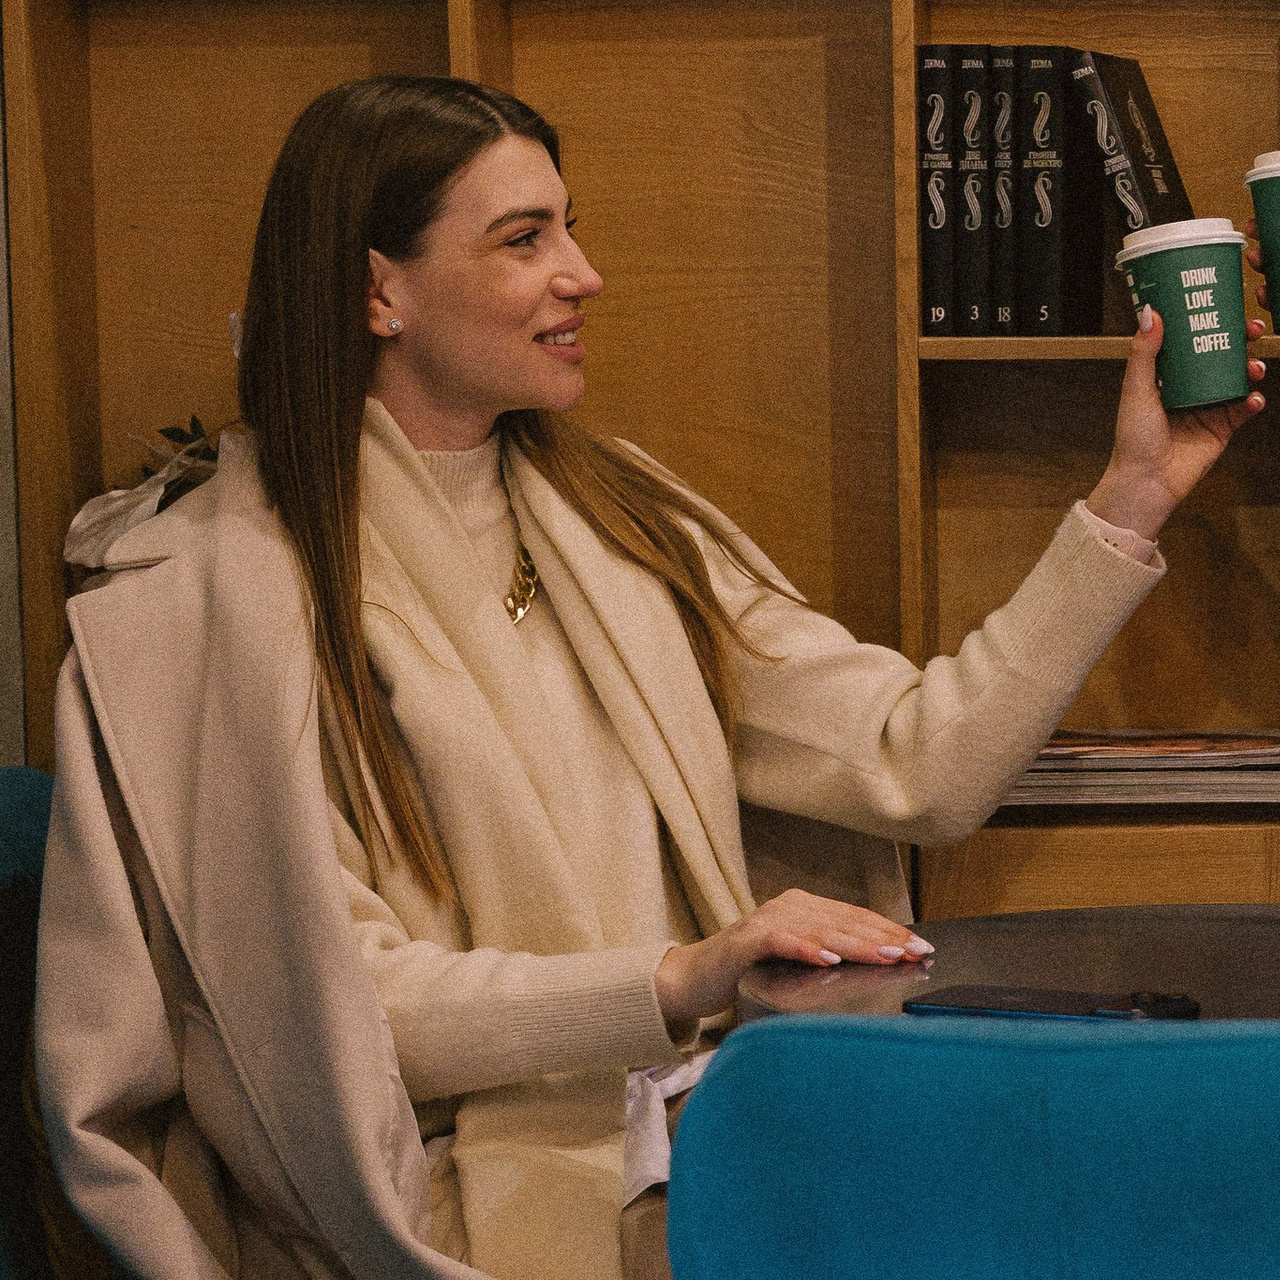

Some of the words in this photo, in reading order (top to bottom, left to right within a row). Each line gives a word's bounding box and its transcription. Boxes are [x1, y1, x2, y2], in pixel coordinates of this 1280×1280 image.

[1180, 267, 1218, 288] DRINK
[1184, 289, 1215, 310] LOVE
[931, 307, 945, 322] 19
[970, 305, 979, 320] 3
[998, 307, 1011, 322] 18
[1039, 305, 1048, 321] 5
[1188, 311, 1220, 332] MAKE
[1193, 332, 1231, 354] COFFEE
